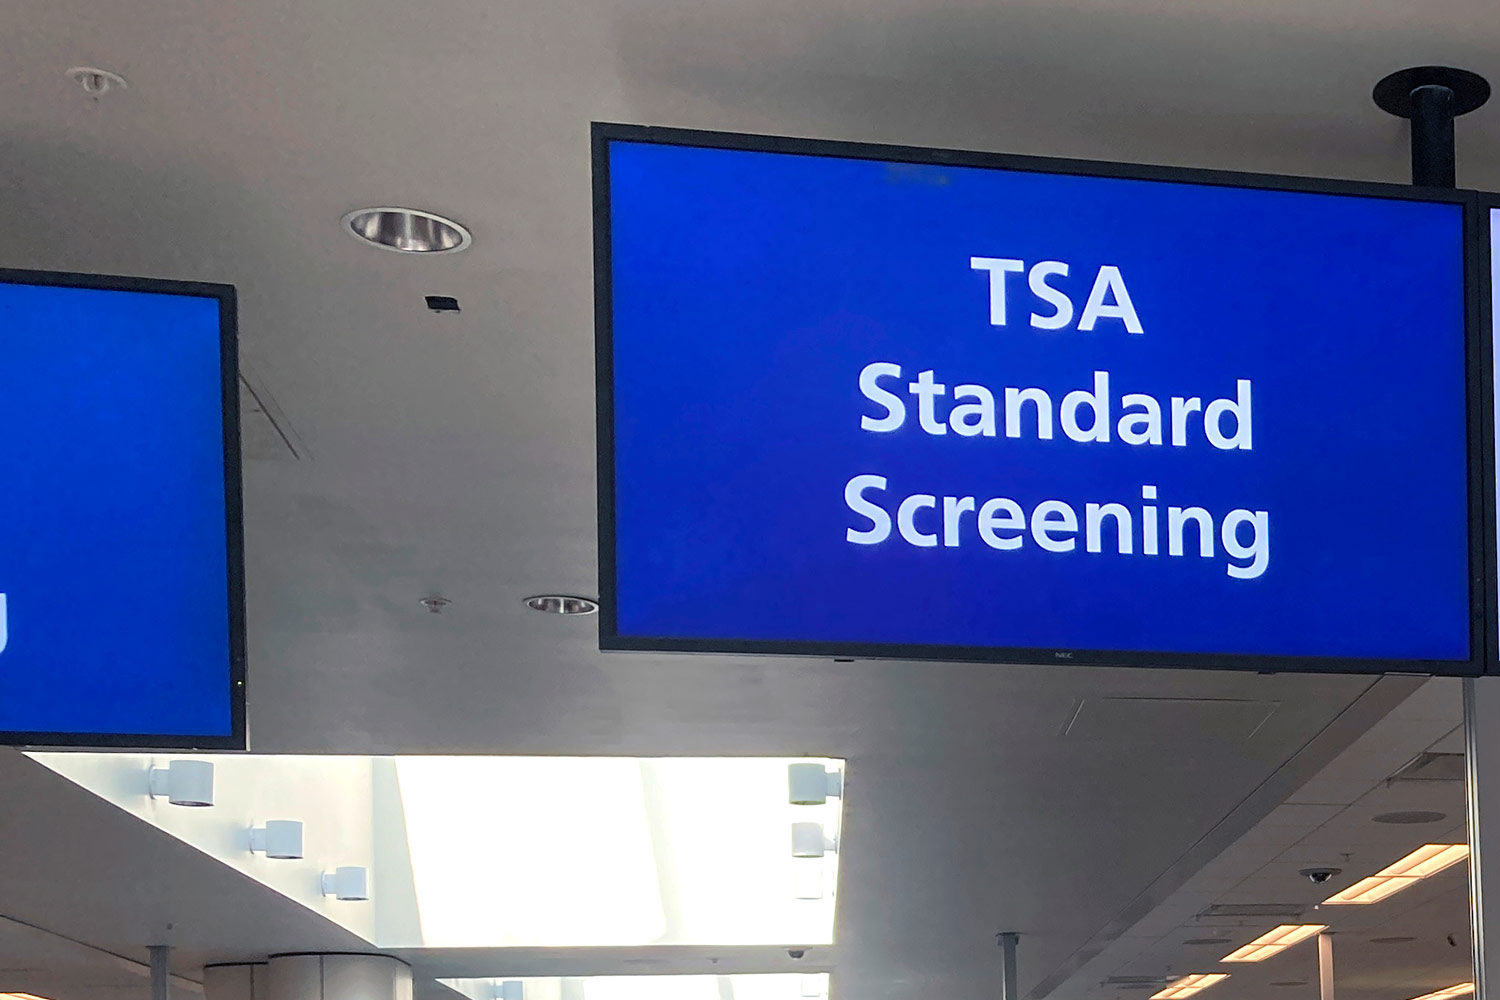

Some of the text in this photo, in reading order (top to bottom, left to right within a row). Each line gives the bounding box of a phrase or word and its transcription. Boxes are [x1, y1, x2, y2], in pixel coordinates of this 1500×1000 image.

[970, 256, 1144, 335] TSA
[858, 362, 1253, 450] Standard
[844, 474, 1270, 579] Screening
